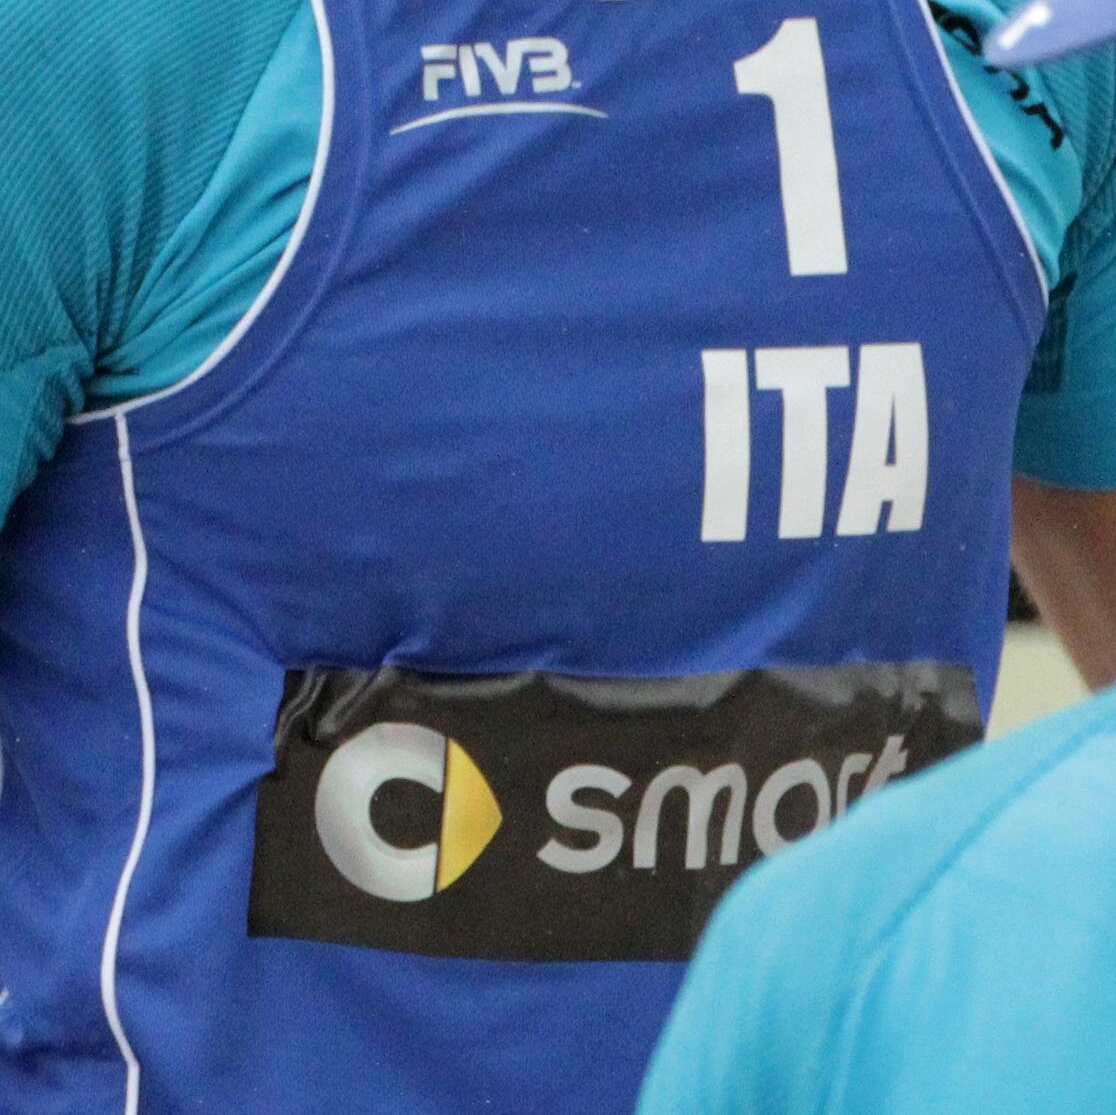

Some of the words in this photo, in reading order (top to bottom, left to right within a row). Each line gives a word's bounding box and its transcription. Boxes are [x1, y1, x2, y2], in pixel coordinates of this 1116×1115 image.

[420, 37, 574, 101] FIVB
[734, 17, 847, 276] 1
[701, 343, 928, 541] ITA
